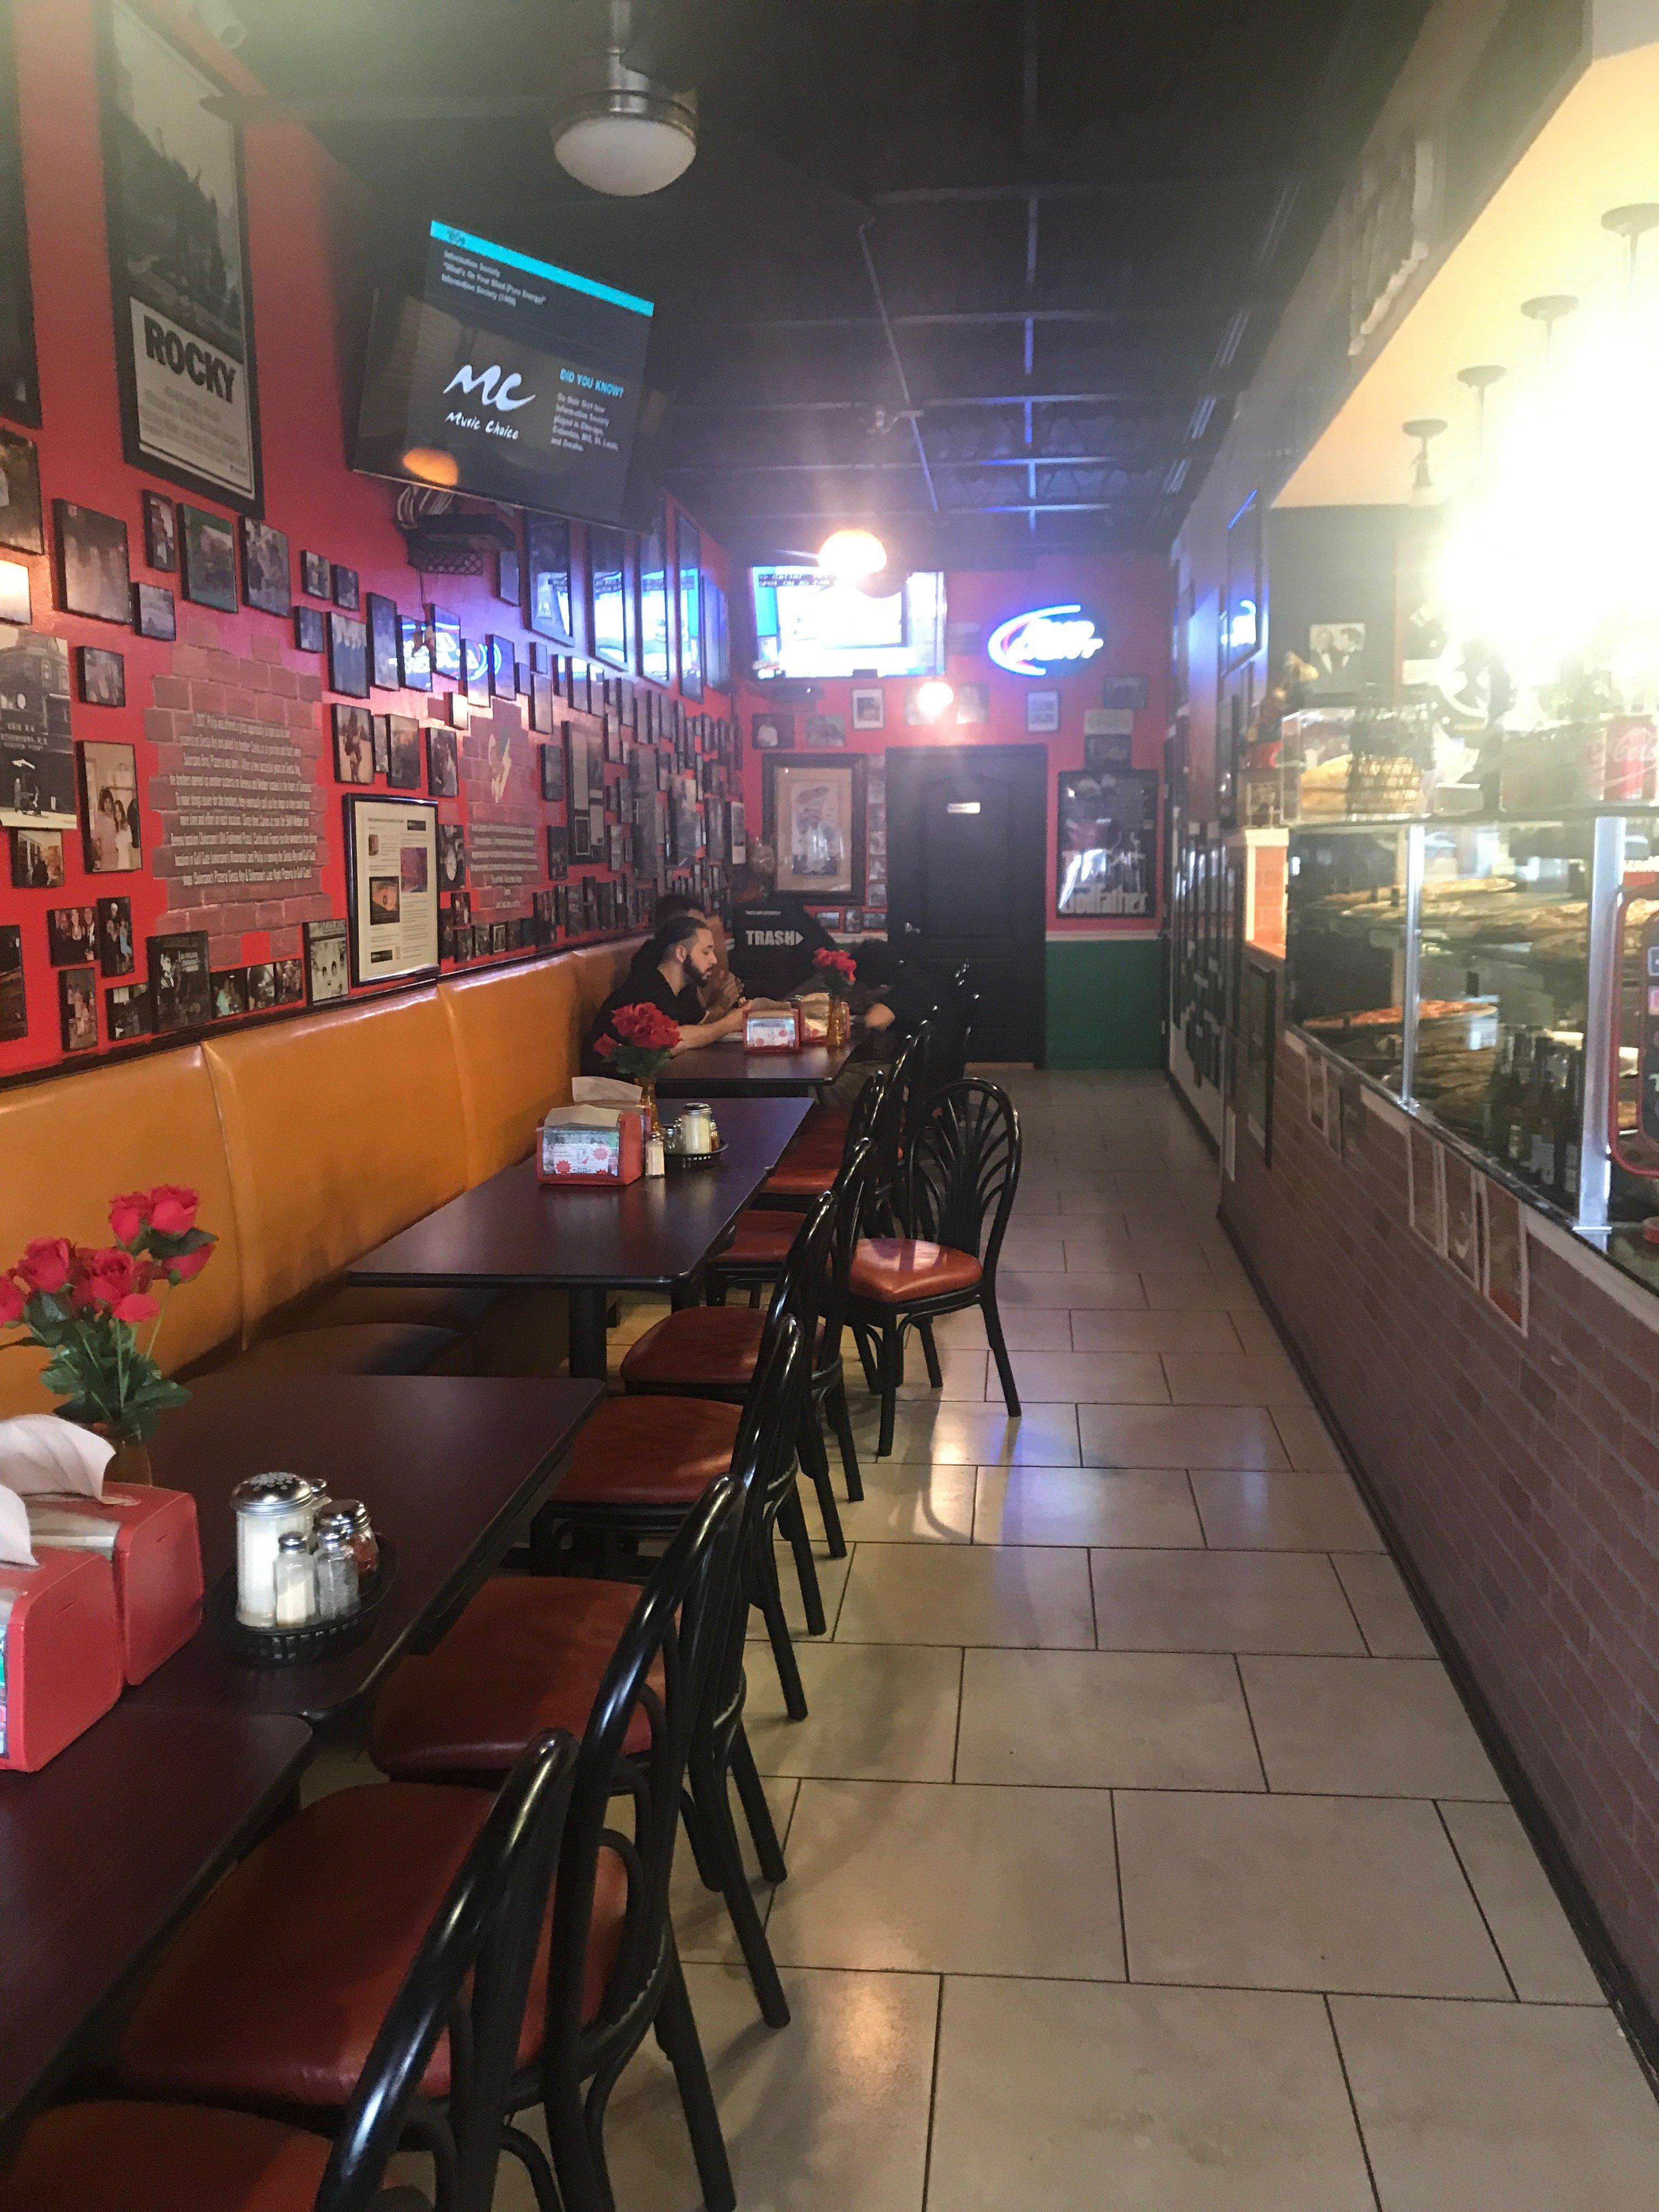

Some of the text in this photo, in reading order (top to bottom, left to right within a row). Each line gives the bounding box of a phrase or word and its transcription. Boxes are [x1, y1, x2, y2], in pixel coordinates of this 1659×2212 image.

[144, 314, 236, 404] ROCKY
[443, 364, 535, 411] MC
[560, 368, 575, 383] DID
[577, 373, 594, 389] YOU
[445, 411, 520, 440] Music Choice
[746, 930, 796, 946] TRASH
